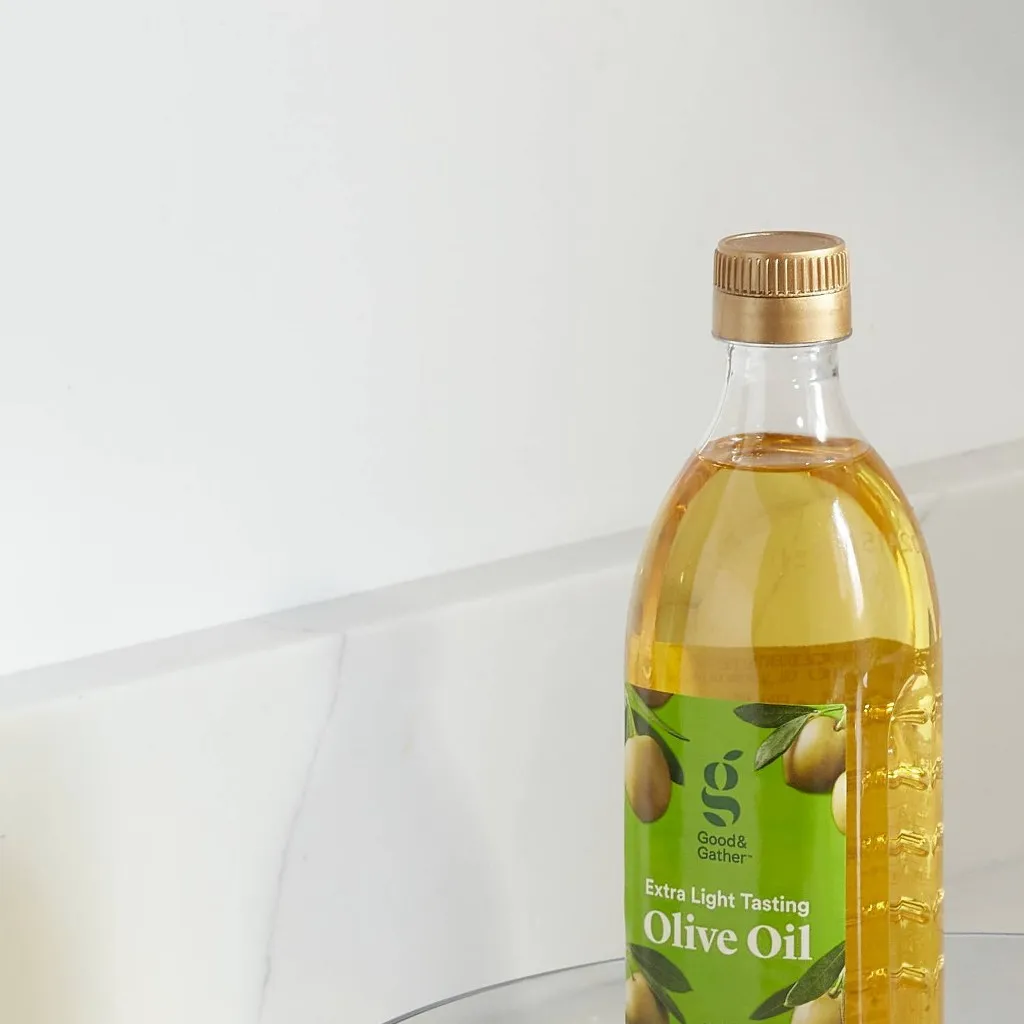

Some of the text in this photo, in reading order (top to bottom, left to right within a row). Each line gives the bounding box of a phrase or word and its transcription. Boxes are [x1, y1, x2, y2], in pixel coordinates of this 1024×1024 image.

[697, 830, 748, 850] Good&
[645, 878, 810, 917] Extra Light Tasting
[643, 910, 813, 961] Olive Oil
